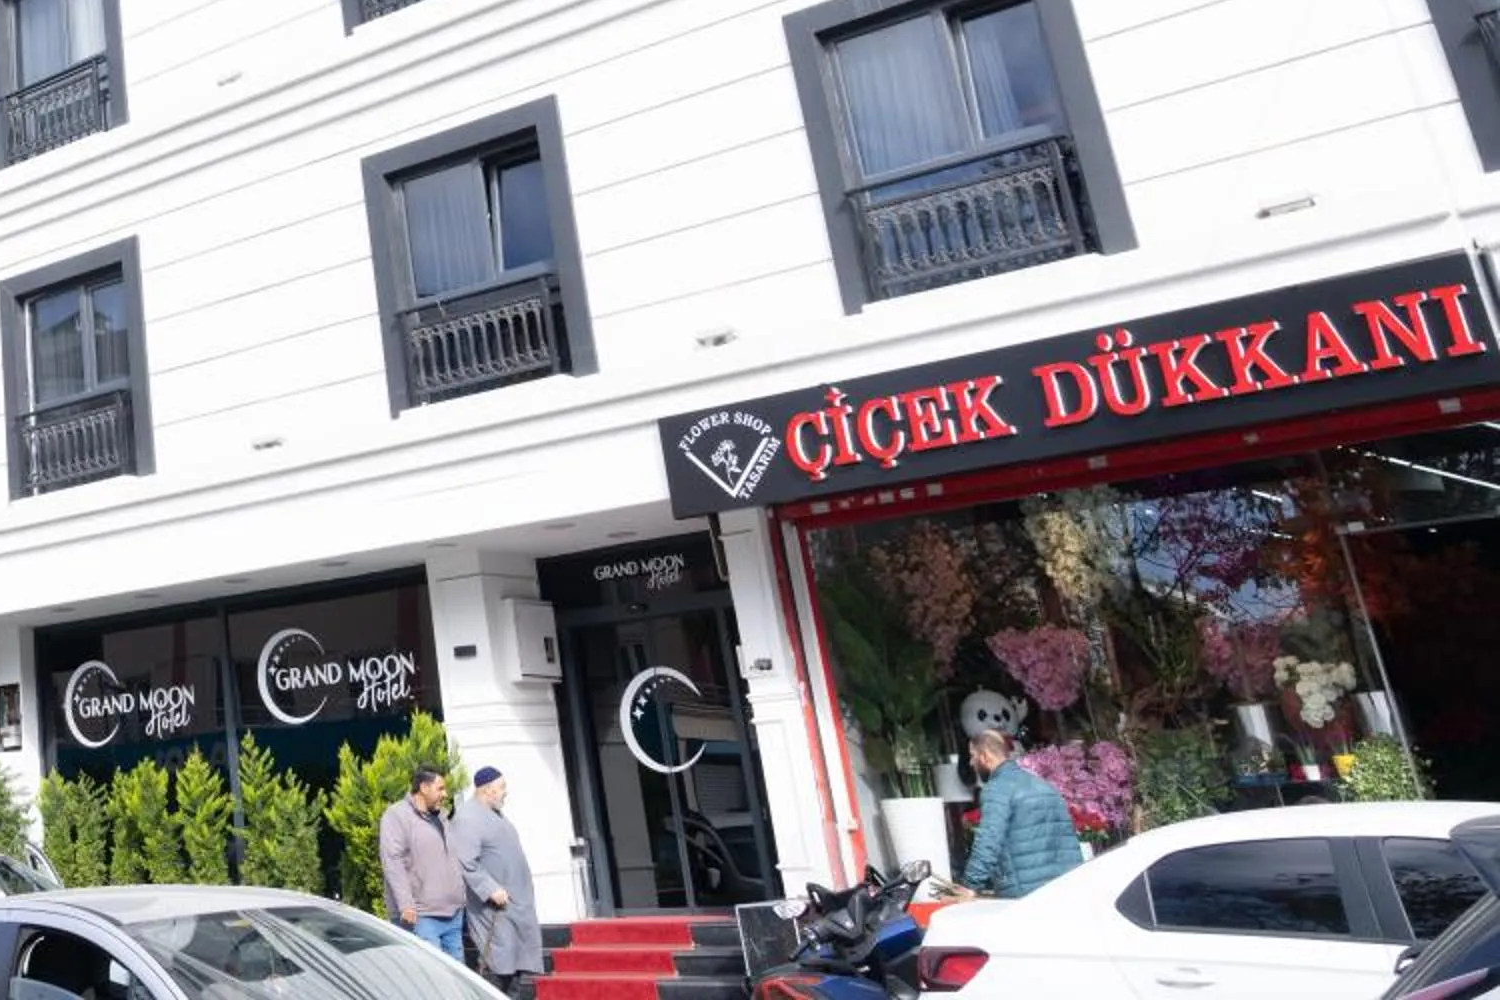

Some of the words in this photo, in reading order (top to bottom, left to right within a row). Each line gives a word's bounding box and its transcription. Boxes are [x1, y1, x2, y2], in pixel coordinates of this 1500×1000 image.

[786, 374, 1018, 481] ÇİÇEK
[1033, 283, 1487, 428] DÜKKANI
[679, 411, 731, 452] FLOWER
[733, 411, 773, 435] SHOP
[739, 436, 781, 499] TASARIM
[593, 560, 638, 580] GRAND
[640, 553, 685, 574] MOON
[275, 662, 343, 691] GRAND
[347, 652, 416, 682] MOON
[79, 693, 135, 719] GRAND
[139, 684, 195, 711] MOON
[357, 672, 411, 712] Hotel
[145, 699, 191, 739] Hotel
